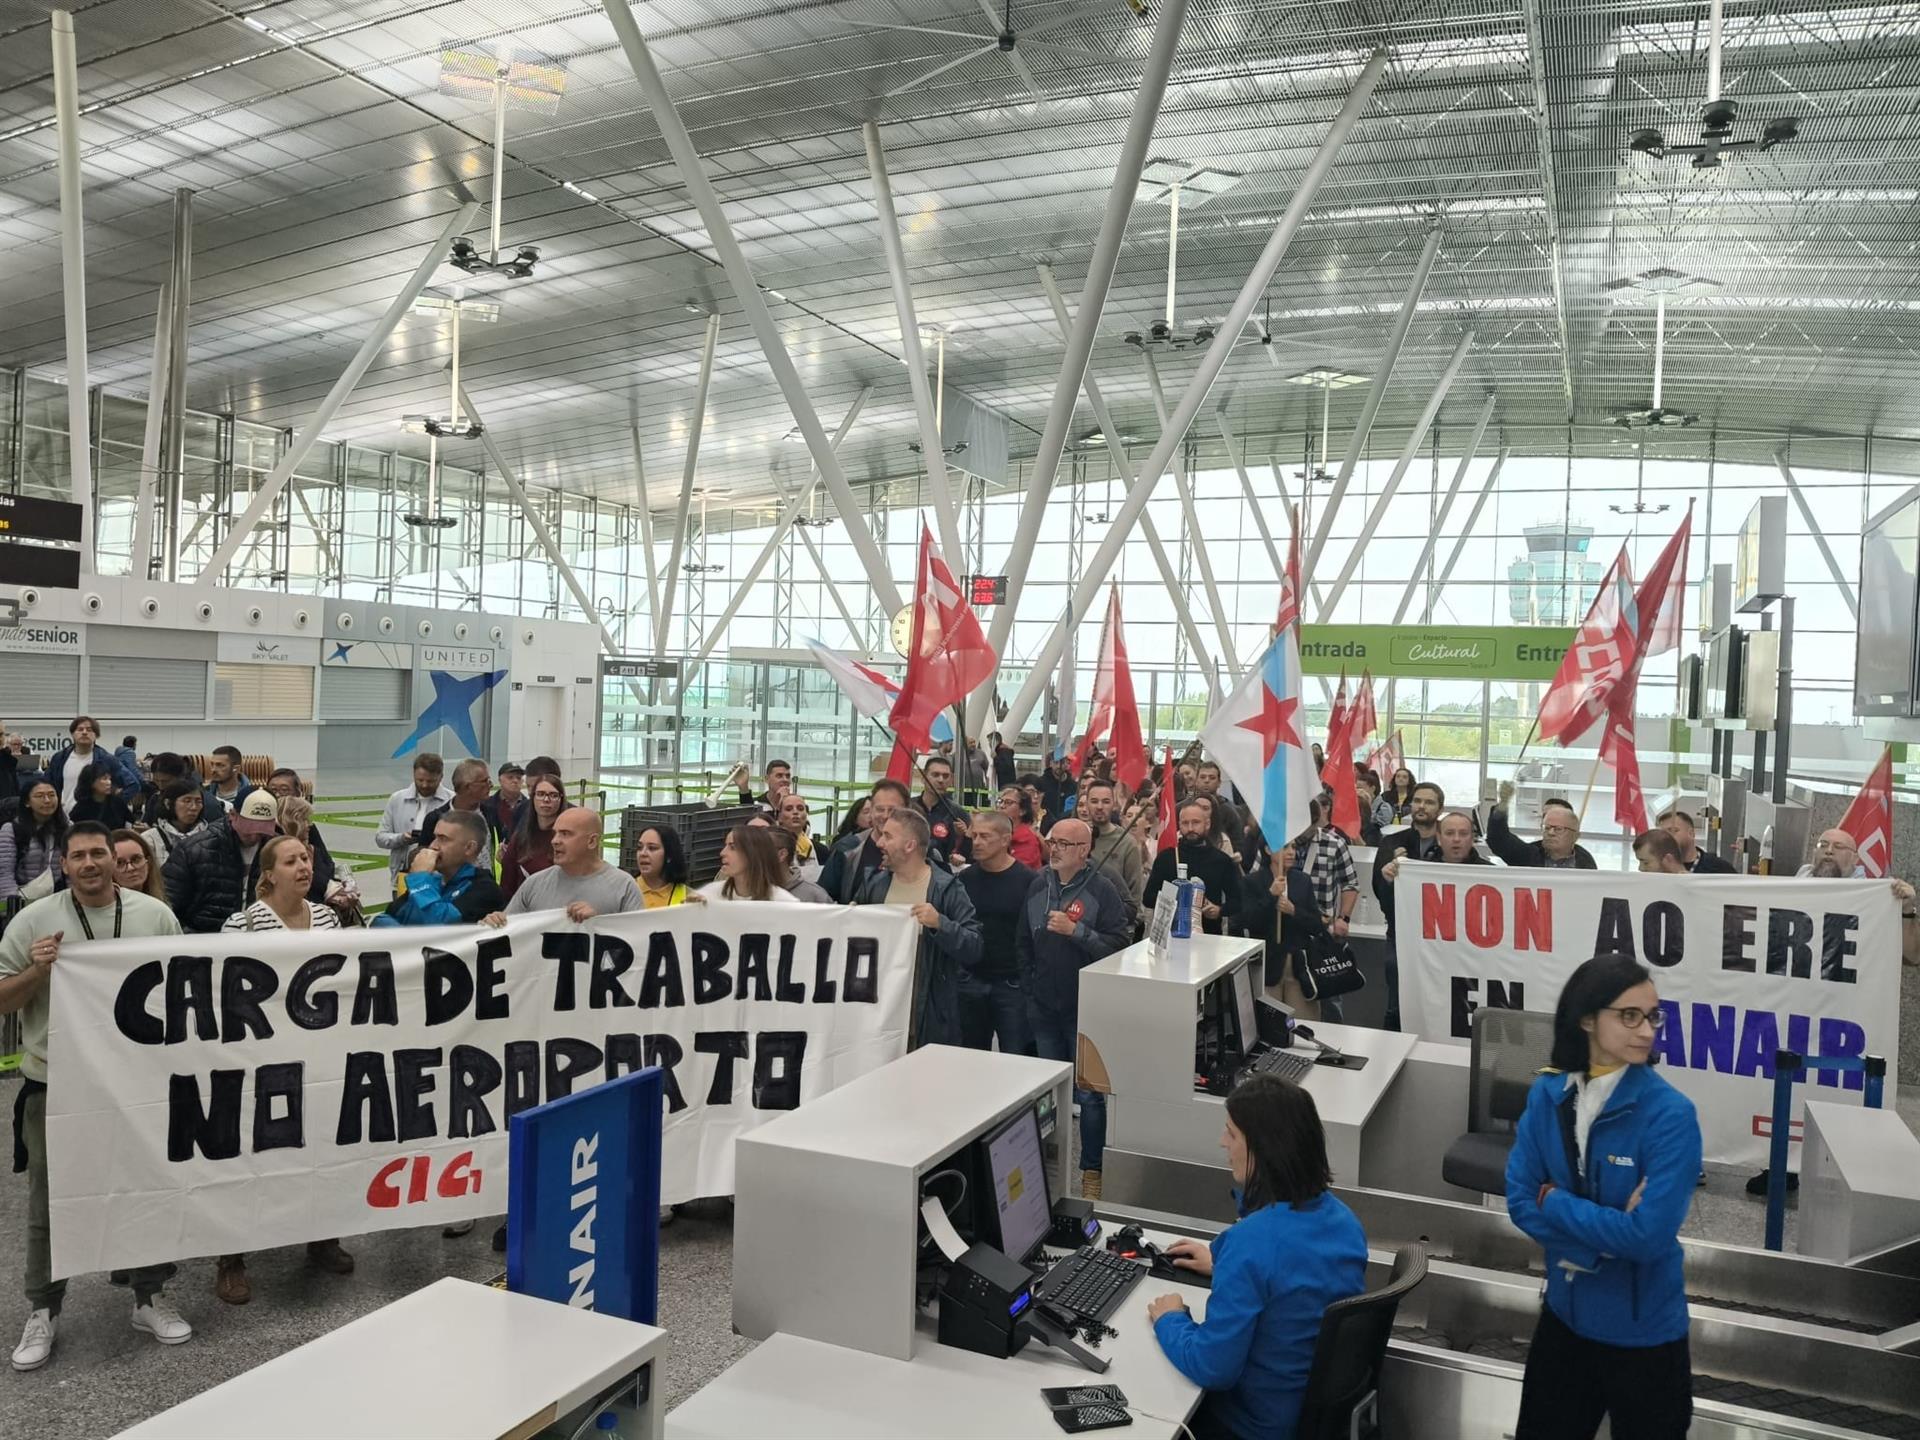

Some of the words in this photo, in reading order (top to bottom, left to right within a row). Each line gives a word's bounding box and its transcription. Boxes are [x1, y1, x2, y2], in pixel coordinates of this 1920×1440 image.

[424, 650, 489, 664] UNITED
[1300, 641, 1366, 658] ntrada
[1408, 643, 1480, 661] Cultural
[1421, 882, 1553, 953] NON
[1594, 897, 1685, 968] AO
[1722, 903, 1860, 985] ERE
[114, 952, 399, 1046] CARGA
[422, 934, 513, 1027] DE
[541, 931, 879, 1012] TRABALLO
[1651, 999, 1866, 1092] ANAIR
[167, 1060, 305, 1163] NO
[336, 1031, 808, 1146] AEROPORTO
[366, 1150, 483, 1209] CIG
[567, 1131, 600, 1313] NAIR
